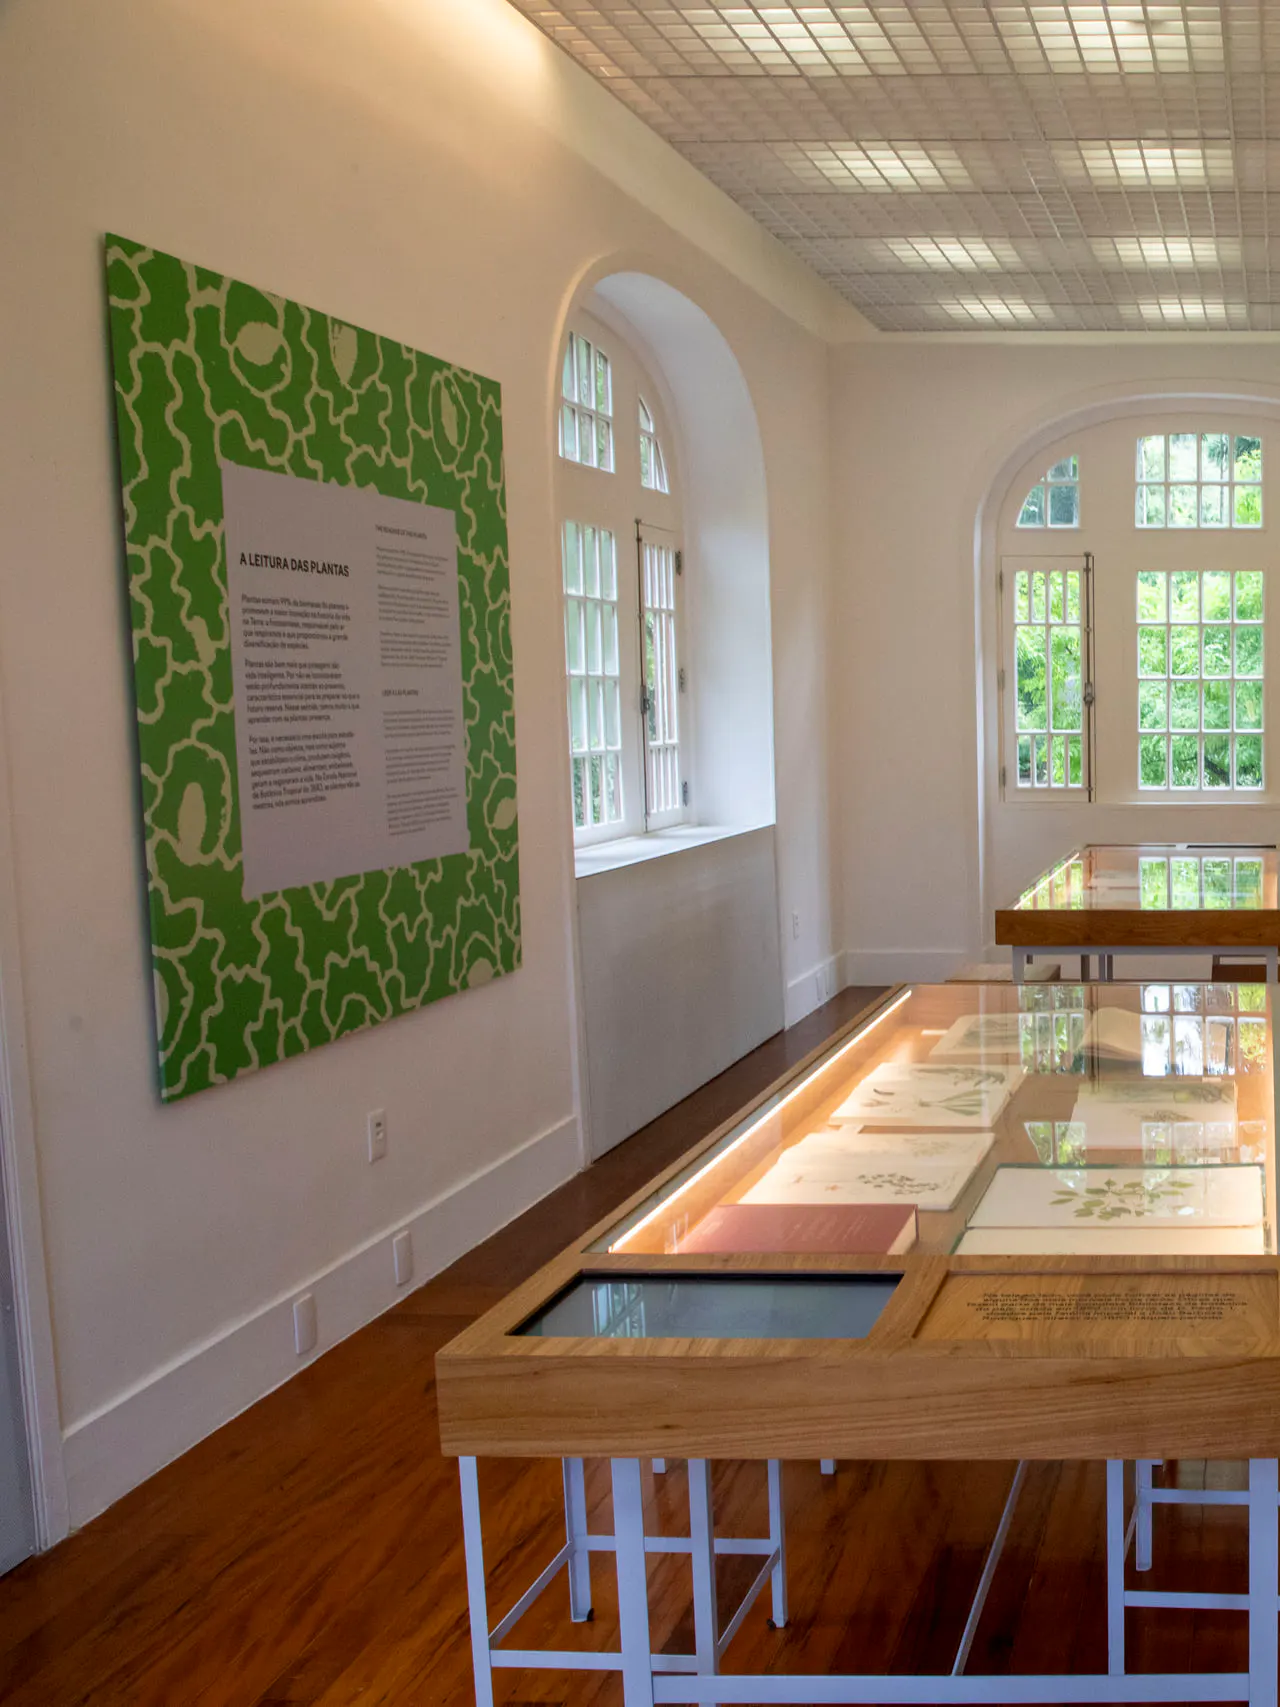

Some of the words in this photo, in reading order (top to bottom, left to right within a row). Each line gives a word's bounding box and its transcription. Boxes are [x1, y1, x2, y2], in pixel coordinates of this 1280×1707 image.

[240, 552, 247, 566] A
[249, 553, 289, 570] LEITURA
[291, 558, 310, 573] DAS
[311, 561, 349, 577] PLANTAS
